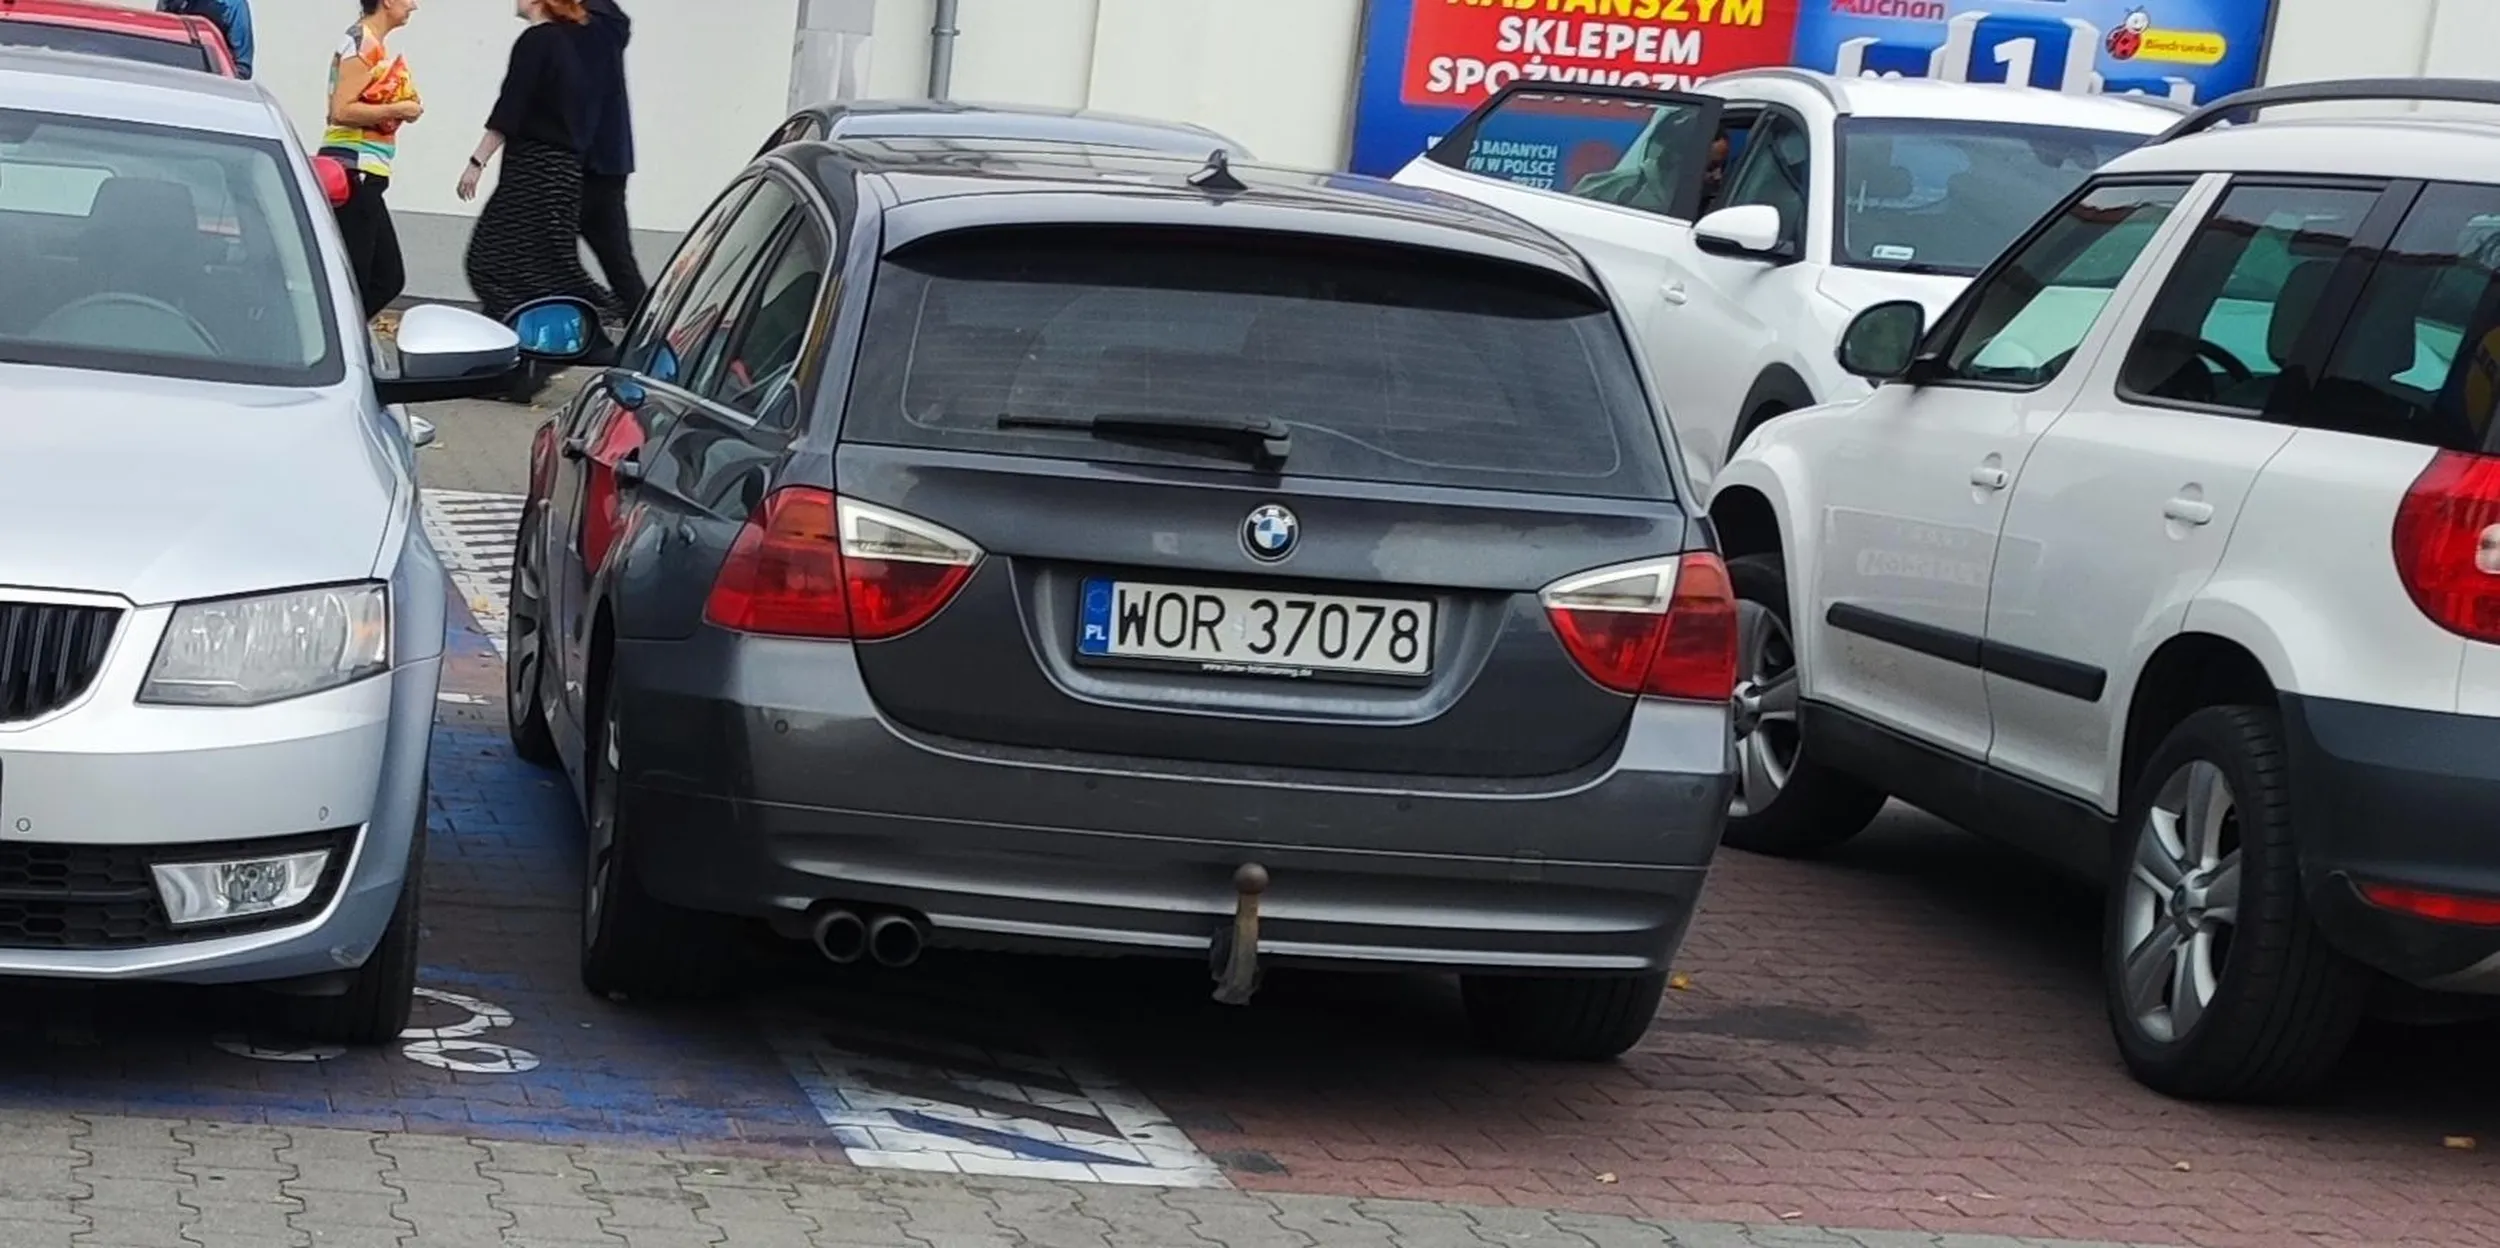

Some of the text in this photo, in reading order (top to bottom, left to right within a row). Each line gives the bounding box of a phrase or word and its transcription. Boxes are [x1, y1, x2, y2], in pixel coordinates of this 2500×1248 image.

[1497, 17, 1702, 65] SKLEPEM
[1993, 37, 2036, 88] 1
[1482, 139, 1557, 159] BADANYCH
[1503, 158, 1556, 176] POLSCE
[1084, 624, 1107, 641] PL
[1118, 590, 1420, 664] WOR 37078
